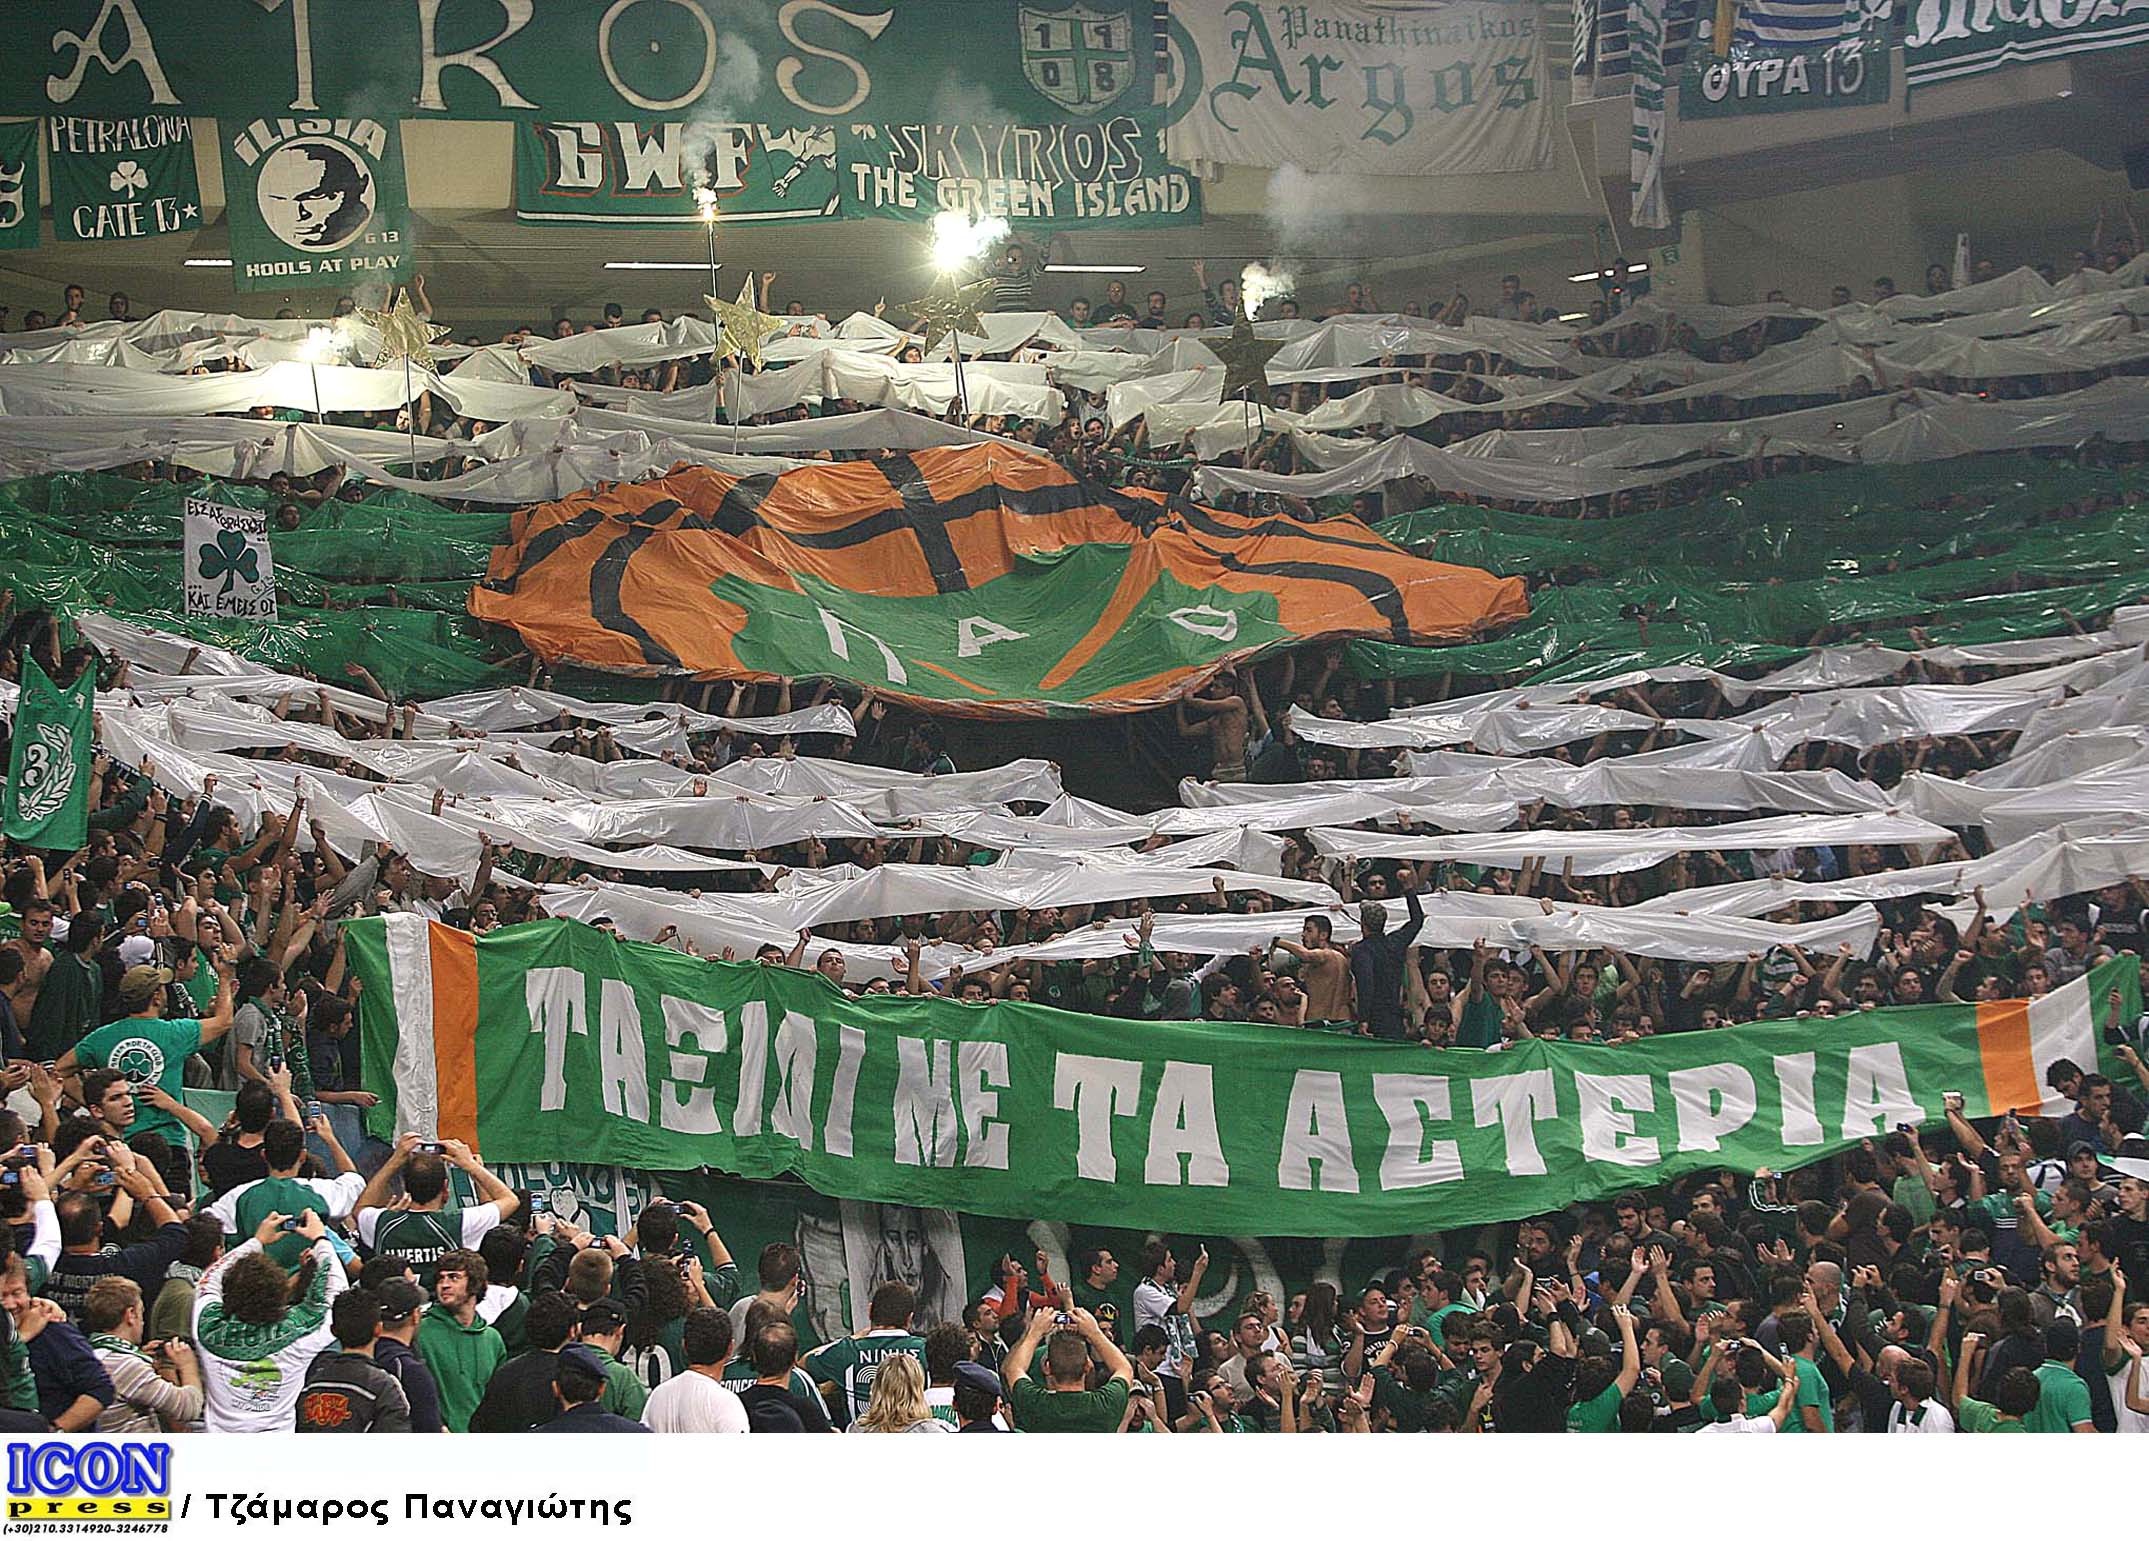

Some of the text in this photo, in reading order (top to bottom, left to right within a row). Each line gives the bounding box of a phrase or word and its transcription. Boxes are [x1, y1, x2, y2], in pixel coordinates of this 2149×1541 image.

[1209, 0, 1539, 146] Argos
[51, 114, 192, 153] PETRALONA
[885, 116, 1143, 191] SKYROS
[851, 163, 1191, 219] THE GREEN ISLAND
[72, 197, 181, 238] GATE 13
[382, 231, 400, 243] 13
[246, 254, 400, 278] HOOLS AT PLAY
[525, 965, 1926, 1194] ΤΑΞΙΔΙ ΜΕ ΤΑ ΑΣΤΕΡΙΑ
